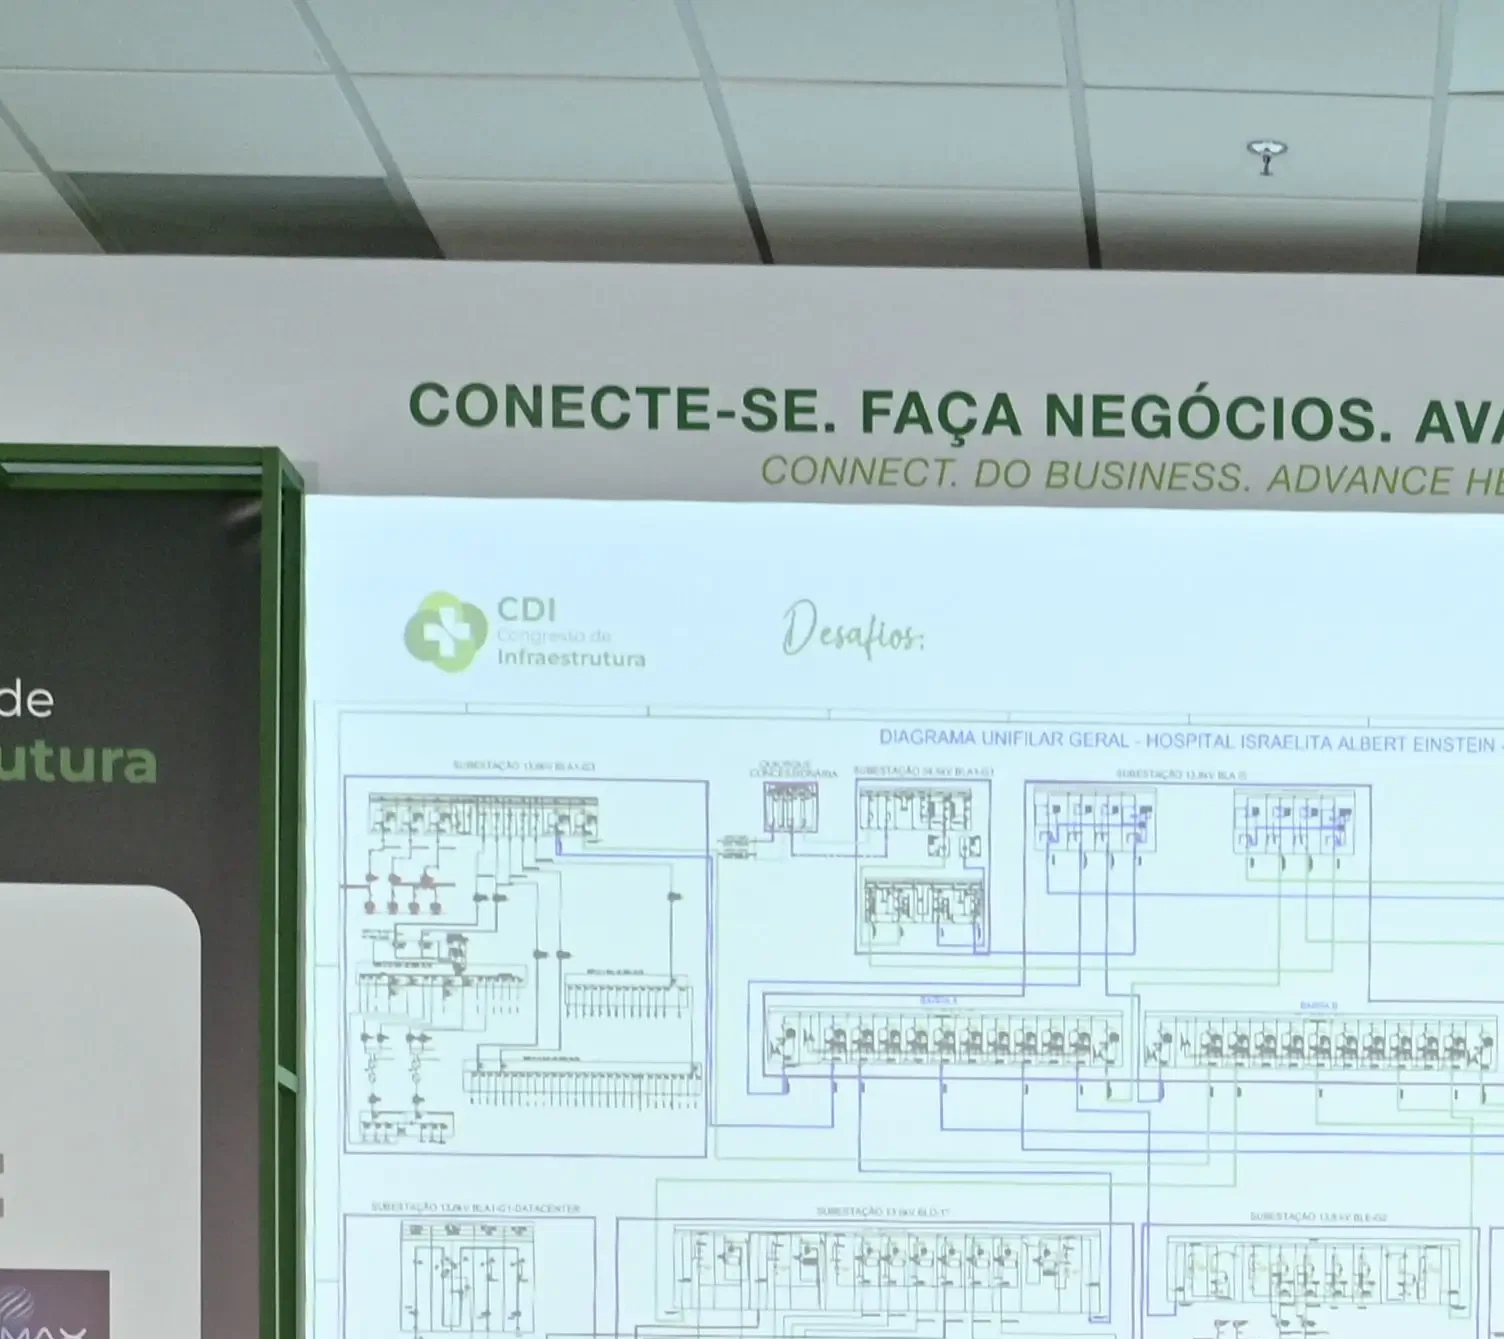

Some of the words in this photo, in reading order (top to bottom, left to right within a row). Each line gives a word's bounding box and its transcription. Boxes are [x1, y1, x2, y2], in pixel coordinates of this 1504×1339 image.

[409, 381, 836, 435] CONECTE-SE.
[862, 389, 1023, 448] FAÇA
[1046, 381, 1392, 444] NEGÓCIOS.
[761, 455, 957, 489] CONNECT.
[974, 458, 1033, 490] DO
[1044, 460, 1251, 494] BUSINESS.
[1266, 464, 1456, 497] ADVANCE
[497, 595, 556, 623] CDI
[497, 627, 586, 646] Congresso
[590, 627, 612, 643] de
[498, 647, 646, 668] Infraestrutura
[879, 728, 977, 746] DIAGRAMA
[982, 730, 1064, 747] UNIFILAR
[1069, 731, 1130, 749] GERAL
[1146, 732, 1235, 750] HOSPITAL
[1240, 733, 1333, 751] ISRAELITA
[1337, 735, 1407, 753] ALBERT
[1413, 736, 1496, 754] EINSTEIN
